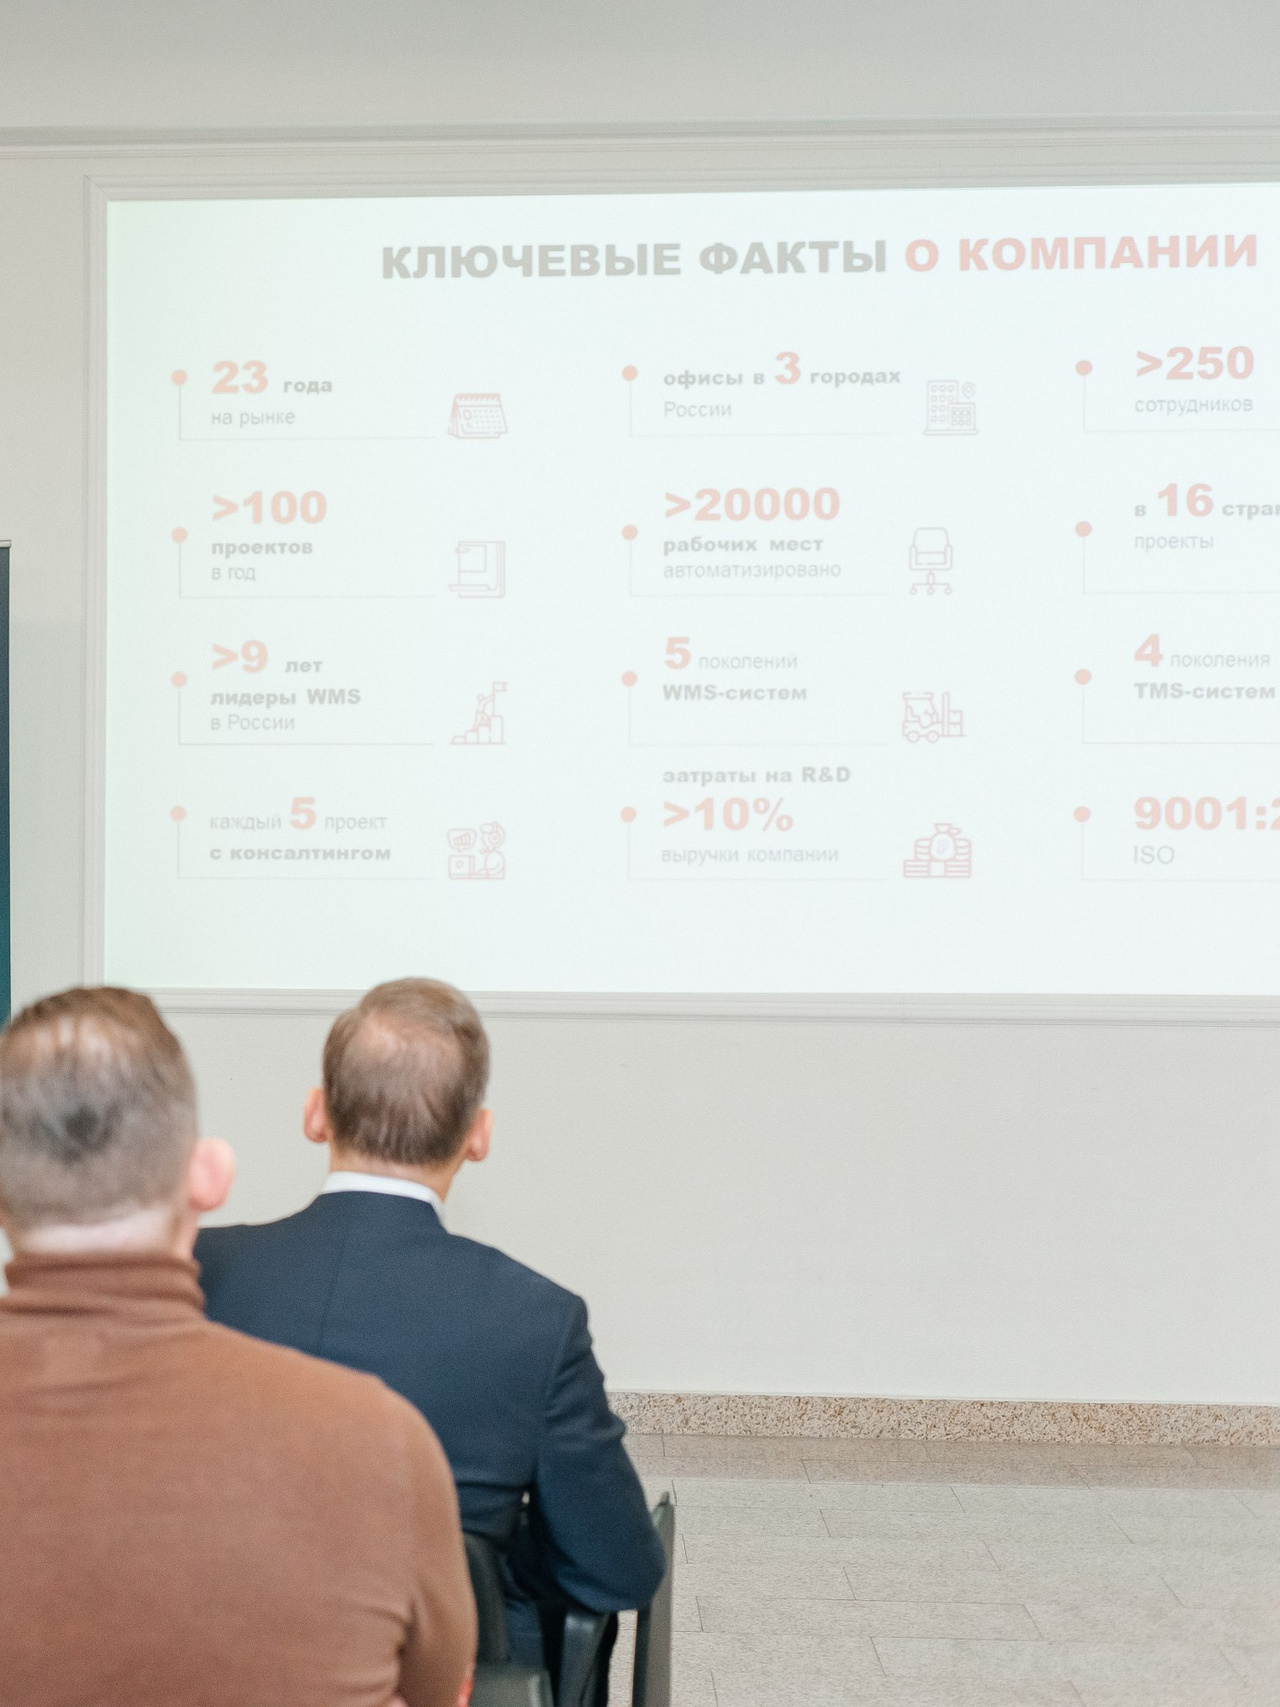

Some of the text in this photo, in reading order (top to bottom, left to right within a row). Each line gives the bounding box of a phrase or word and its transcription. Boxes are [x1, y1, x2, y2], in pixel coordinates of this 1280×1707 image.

[382, 235, 1257, 279] КЛЮЧЕВЫЕ ФАКТЫ О КОМПАНИИ
[663, 351, 901, 389] офисы в 3 городах
[1135, 346, 1255, 380] >250
[211, 360, 333, 395] 23 года
[663, 401, 732, 417] России
[1134, 398, 1253, 416] сотрудников
[211, 411, 296, 428] на рынке
[211, 490, 328, 525] >100
[664, 487, 840, 521] >20000
[1134, 483, 1280, 520] в 16 стра
[211, 540, 313, 558] проектов
[663, 537, 823, 556] рабочих мест
[1134, 535, 1214, 552] проекты
[211, 567, 256, 582] в год
[662, 563, 842, 581] автоматизировано
[211, 639, 323, 674] >9 лет
[664, 636, 799, 670] 5 поколений
[1134, 633, 1271, 668] 4 поколения
[210, 688, 361, 709] лидеры WMS
[662, 684, 807, 701] WMS-систем
[1134, 682, 1276, 699] TMS-систем
[211, 714, 295, 730] в России
[662, 766, 851, 787] затраты на R&D
[210, 796, 388, 833] каждый 5 проект
[662, 797, 794, 831] >10%
[210, 847, 391, 861] с консалтингом
[661, 848, 839, 866] выручки компании
[1134, 845, 1175, 864] ISO
